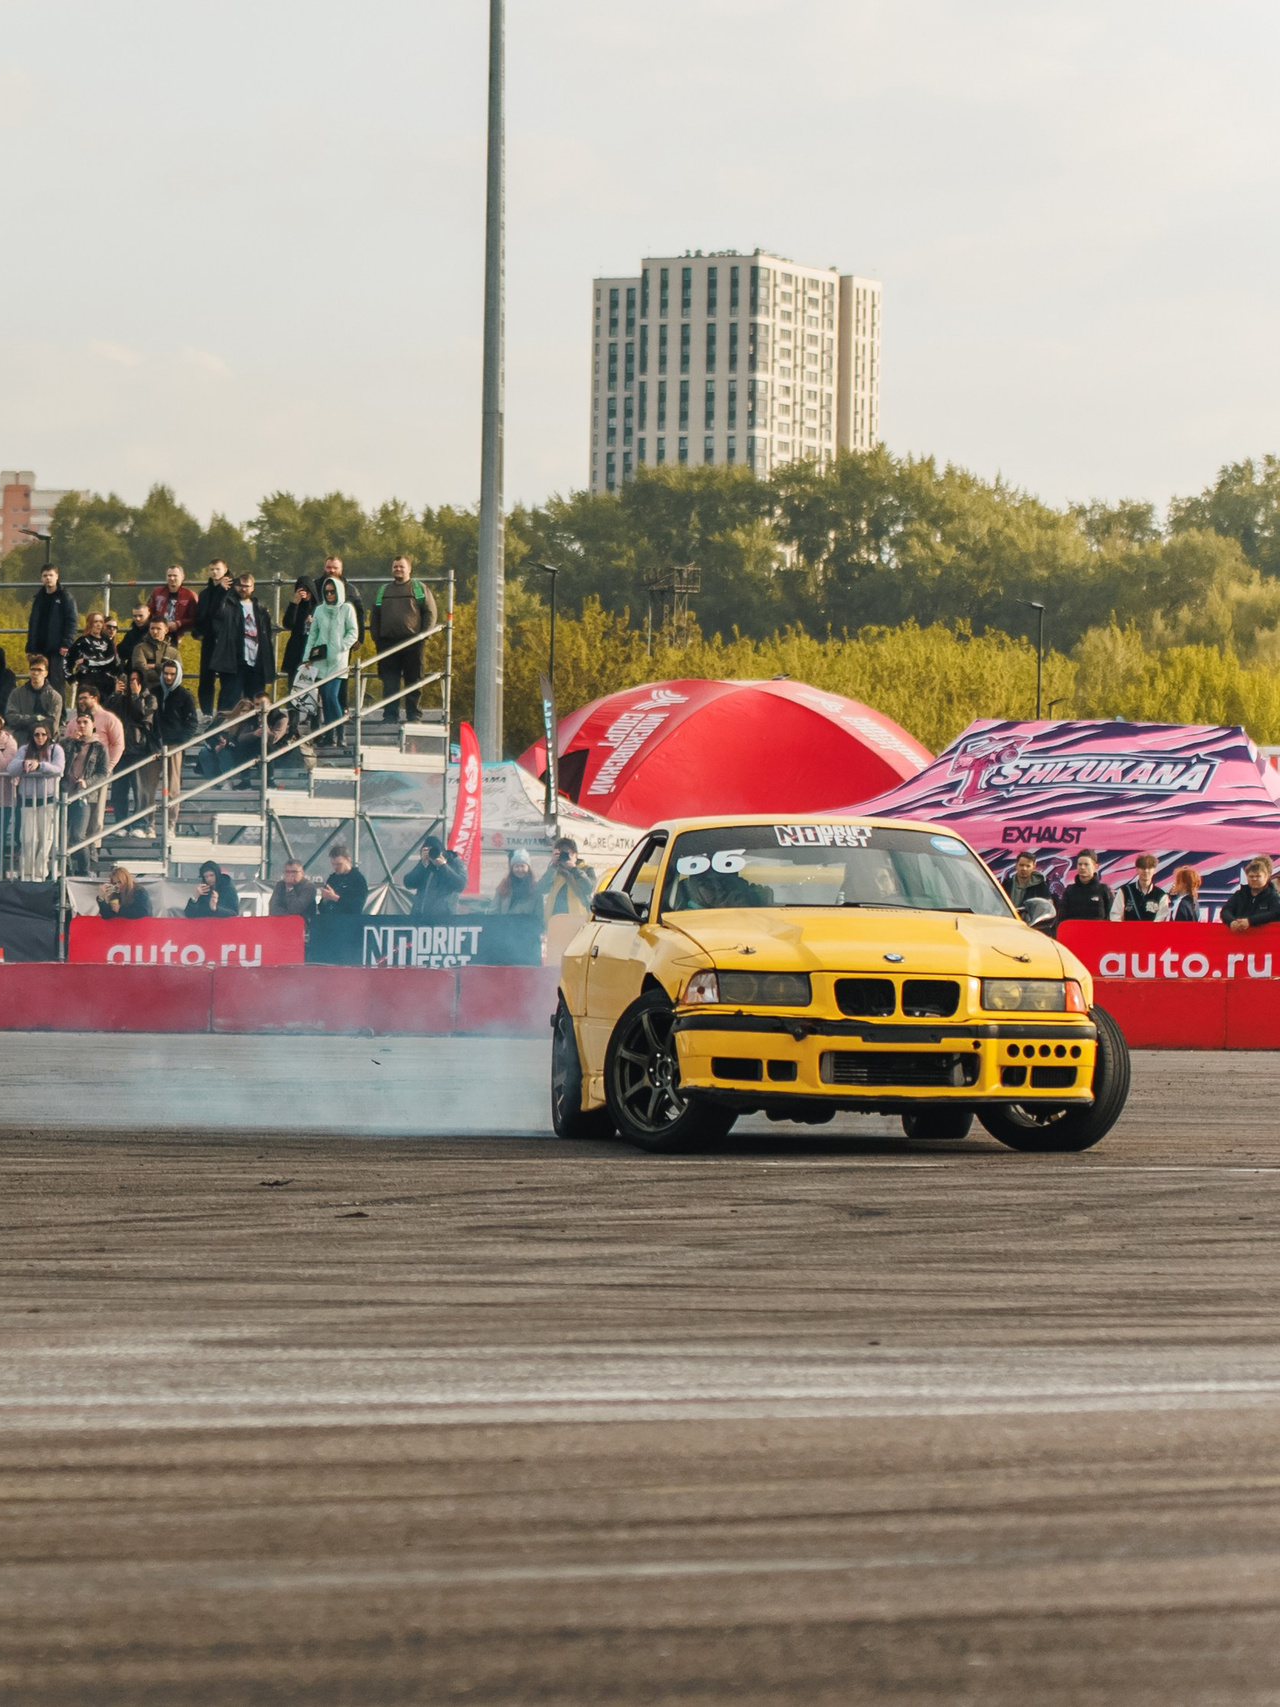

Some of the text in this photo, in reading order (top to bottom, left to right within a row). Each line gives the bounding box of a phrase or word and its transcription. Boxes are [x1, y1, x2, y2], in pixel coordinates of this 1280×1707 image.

[597, 713, 646, 749] СПОРТ
[587, 713, 670, 795] МОСКОВСКИЙ
[991, 758, 1212, 791] SHIZUKANA
[452, 796, 478, 857] AMAY
[819, 825, 872, 837] DRIFT
[823, 836, 869, 847] FEST
[1001, 826, 1087, 845] EXHAUST
[106, 940, 262, 967] auto.ru
[418, 926, 483, 955] DRIFT
[1099, 948, 1272, 979] auto.ru
